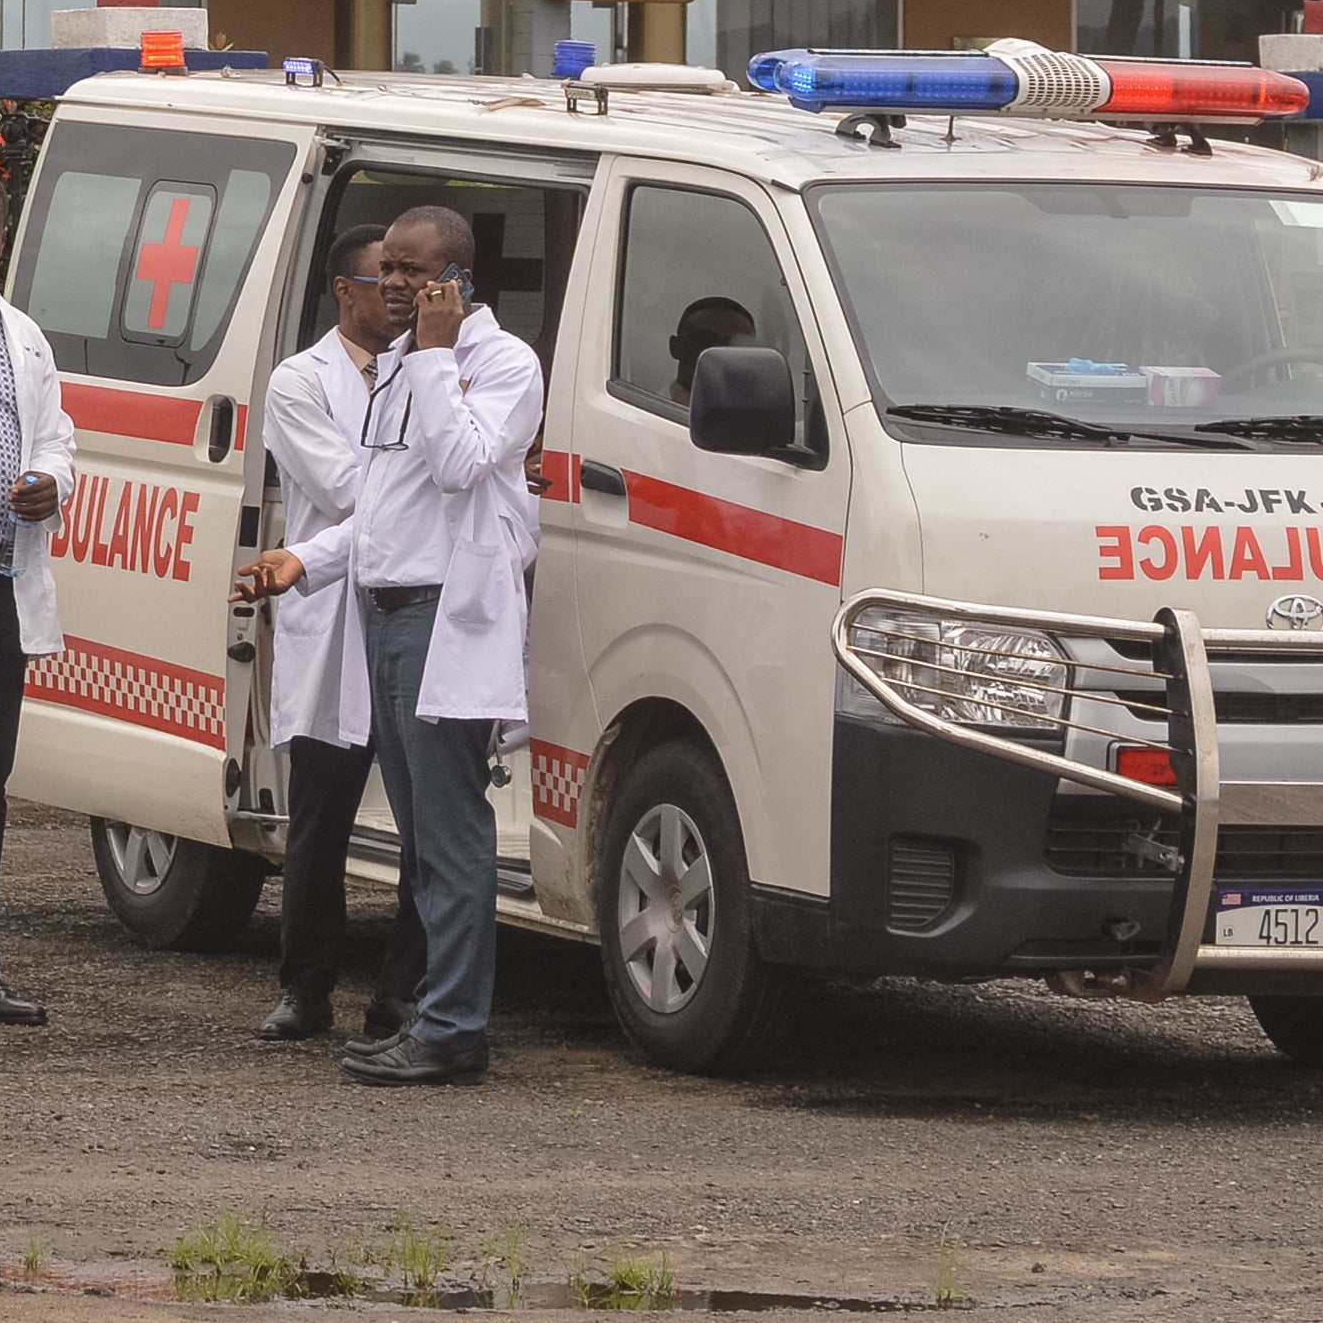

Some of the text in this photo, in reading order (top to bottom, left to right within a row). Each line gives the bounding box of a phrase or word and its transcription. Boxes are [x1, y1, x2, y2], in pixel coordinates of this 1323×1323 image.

[1130, 487, 1323, 514] GSA-JFK
[46, 474, 200, 582] BULANCE
[1295, 894, 1320, 902] LIBERIA
[1223, 929, 1234, 937] LB
[1258, 908, 1319, 944] 4512
